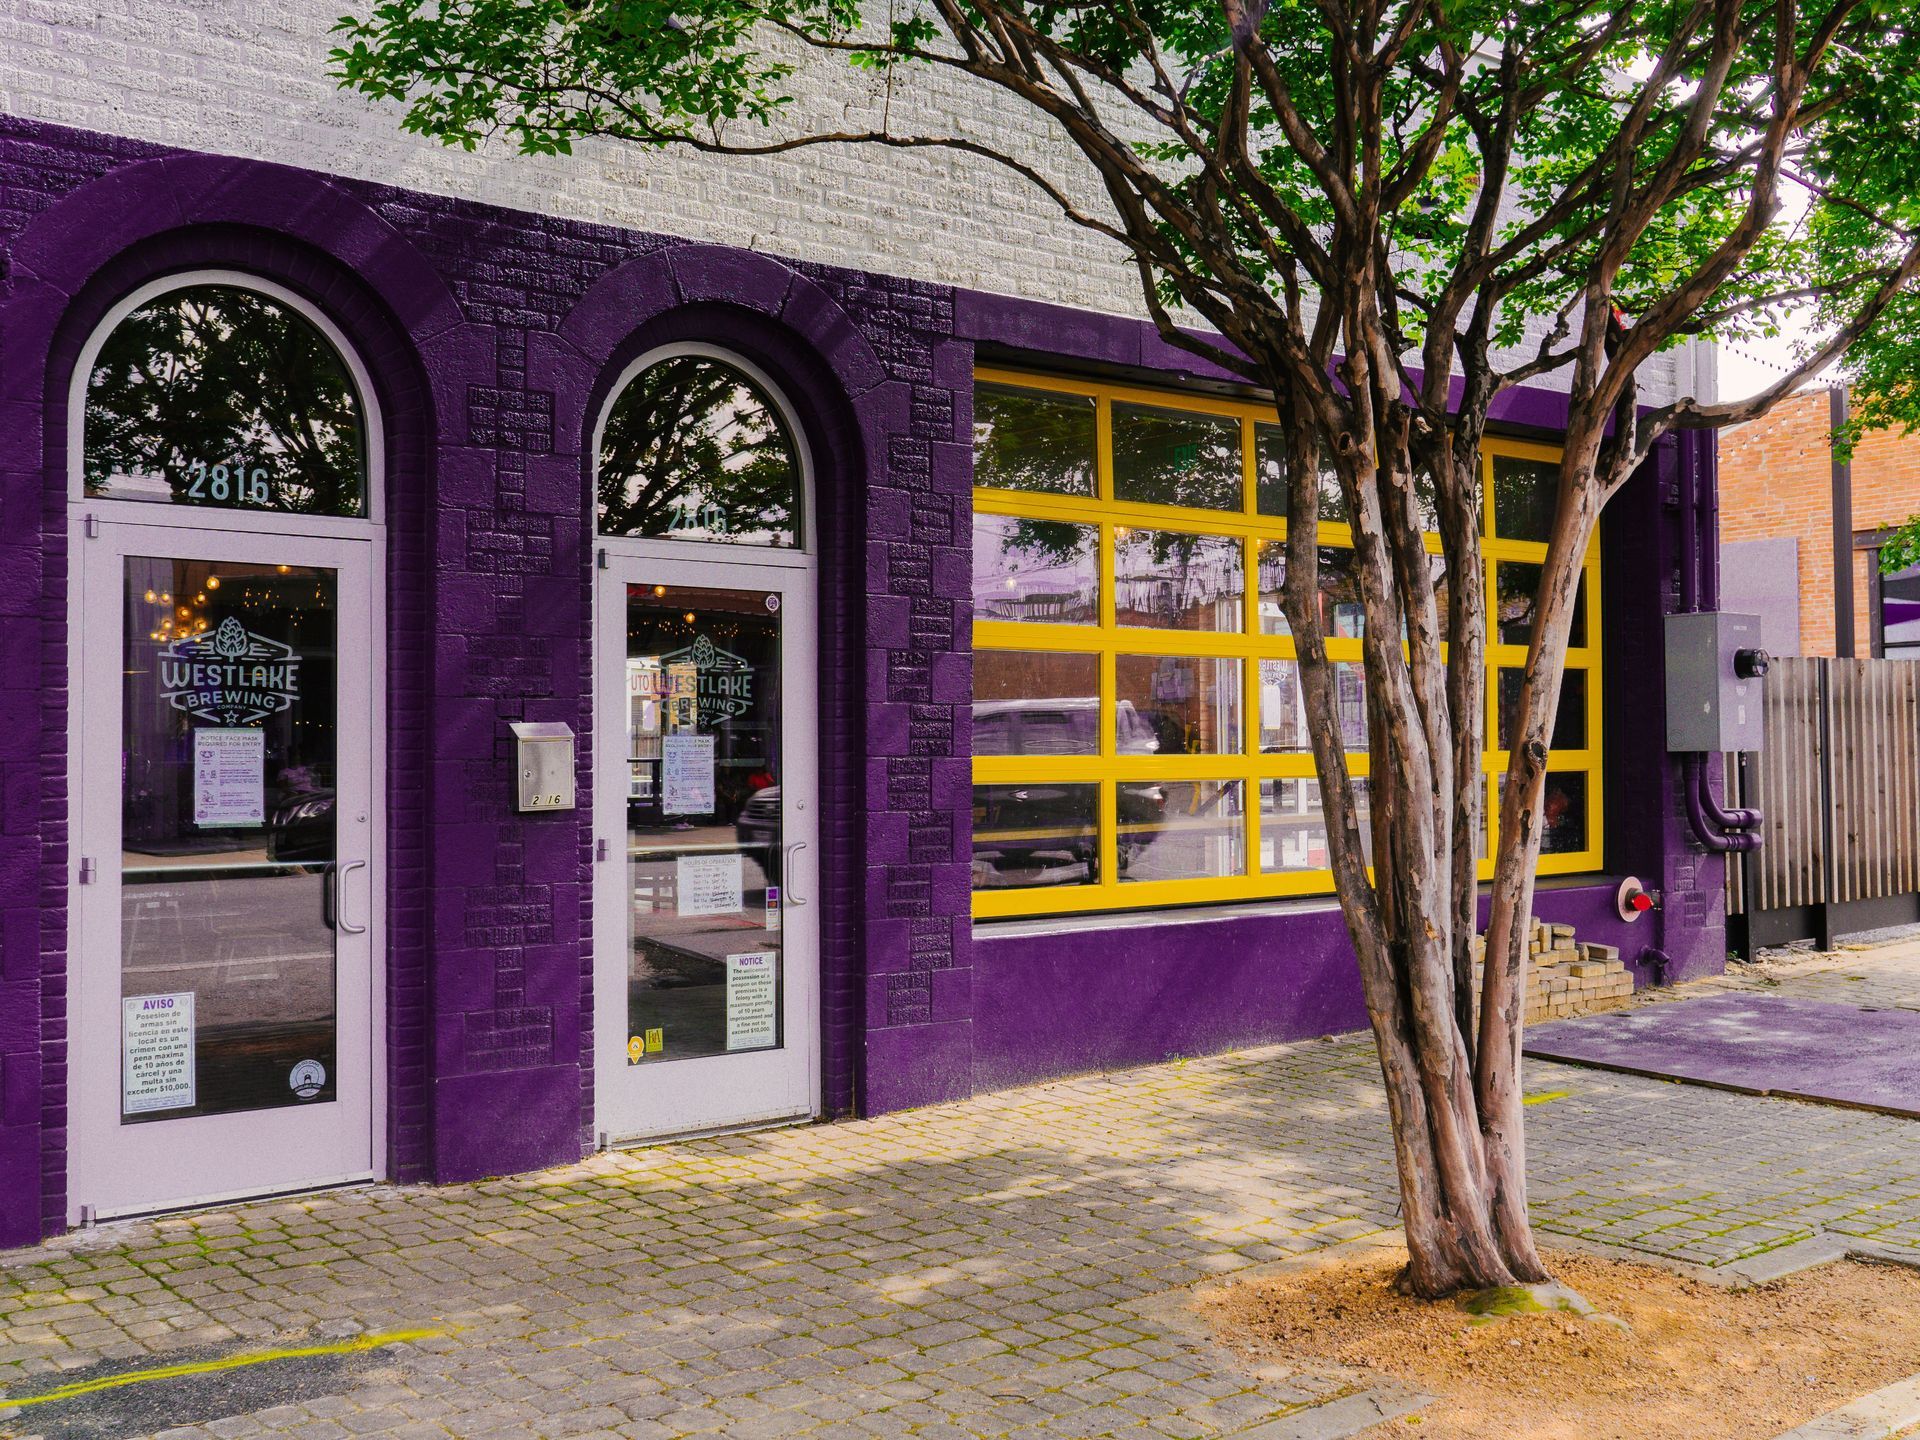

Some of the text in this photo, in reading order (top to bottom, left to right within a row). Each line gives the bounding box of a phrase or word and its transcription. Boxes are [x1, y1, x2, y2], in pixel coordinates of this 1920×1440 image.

[188, 464, 269, 503] 2816
[161, 661, 299, 691] WESTLAKE
[652, 672, 753, 698] WESTLAKE
[186, 690, 276, 709] BREWING
[671, 696, 735, 713] BREWING
[739, 957, 763, 966] NOTICE
[143, 998, 174, 1010] AVISO
[129, 1029, 159, 1037] licencia
[138, 1037, 157, 1045] local
[129, 1046, 156, 1054] crimen
[133, 1055, 152, 1063] pena
[155, 1060, 174, 1068] años
[142, 1078, 163, 1086] multa
[127, 1082, 191, 1096] exceder $10,000.
